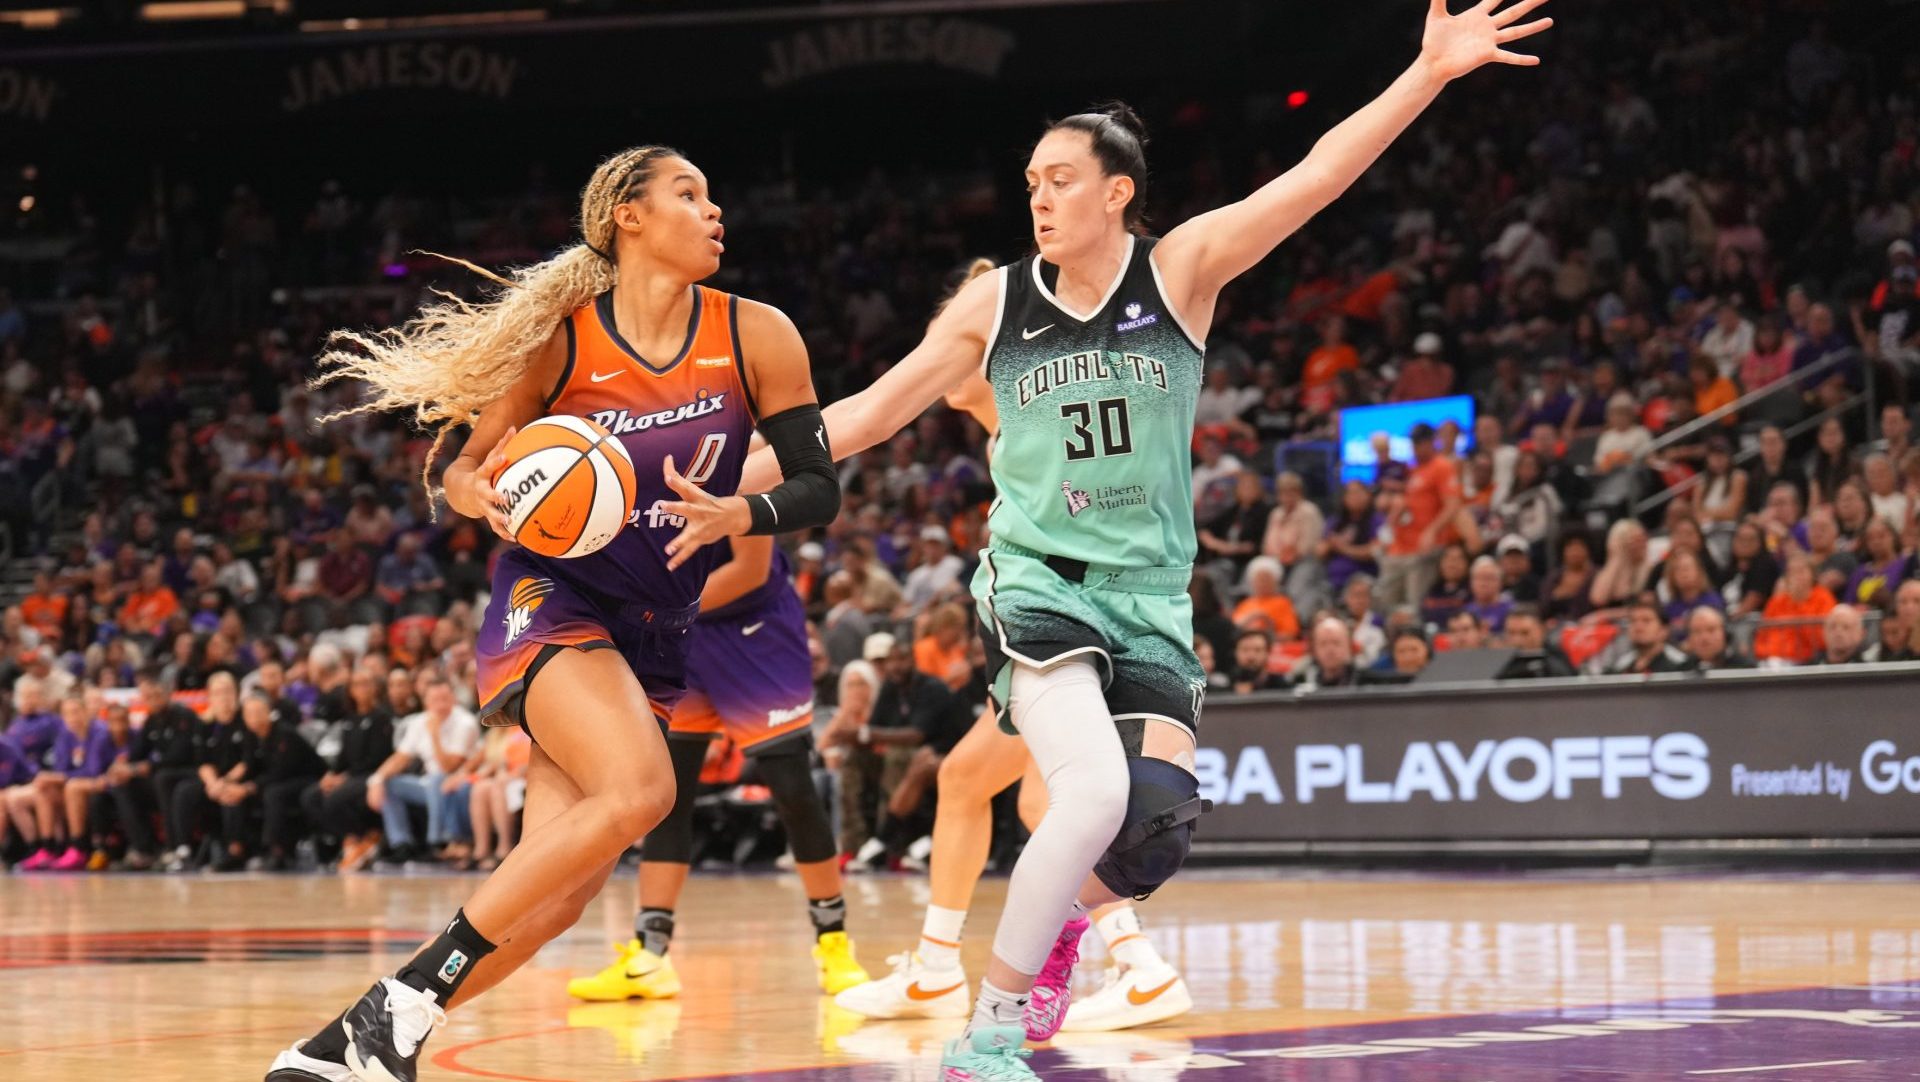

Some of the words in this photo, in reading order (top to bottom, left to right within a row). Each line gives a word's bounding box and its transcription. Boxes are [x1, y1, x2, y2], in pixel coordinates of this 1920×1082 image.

[283, 42, 517, 110] JAMESON
[1117, 314, 1156, 332] BARCLAYS
[590, 388, 726, 436] Phoenix
[1061, 398, 1133, 461] 30
[683, 432, 728, 486] 0
[496, 468, 548, 516] ilson
[1096, 483, 1146, 501] Liberty
[1096, 493, 1147, 511] Mutual
[1295, 732, 1710, 804] PLAYOFFS
[1731, 763, 1822, 797] Presented
[1825, 761, 1851, 802] by
